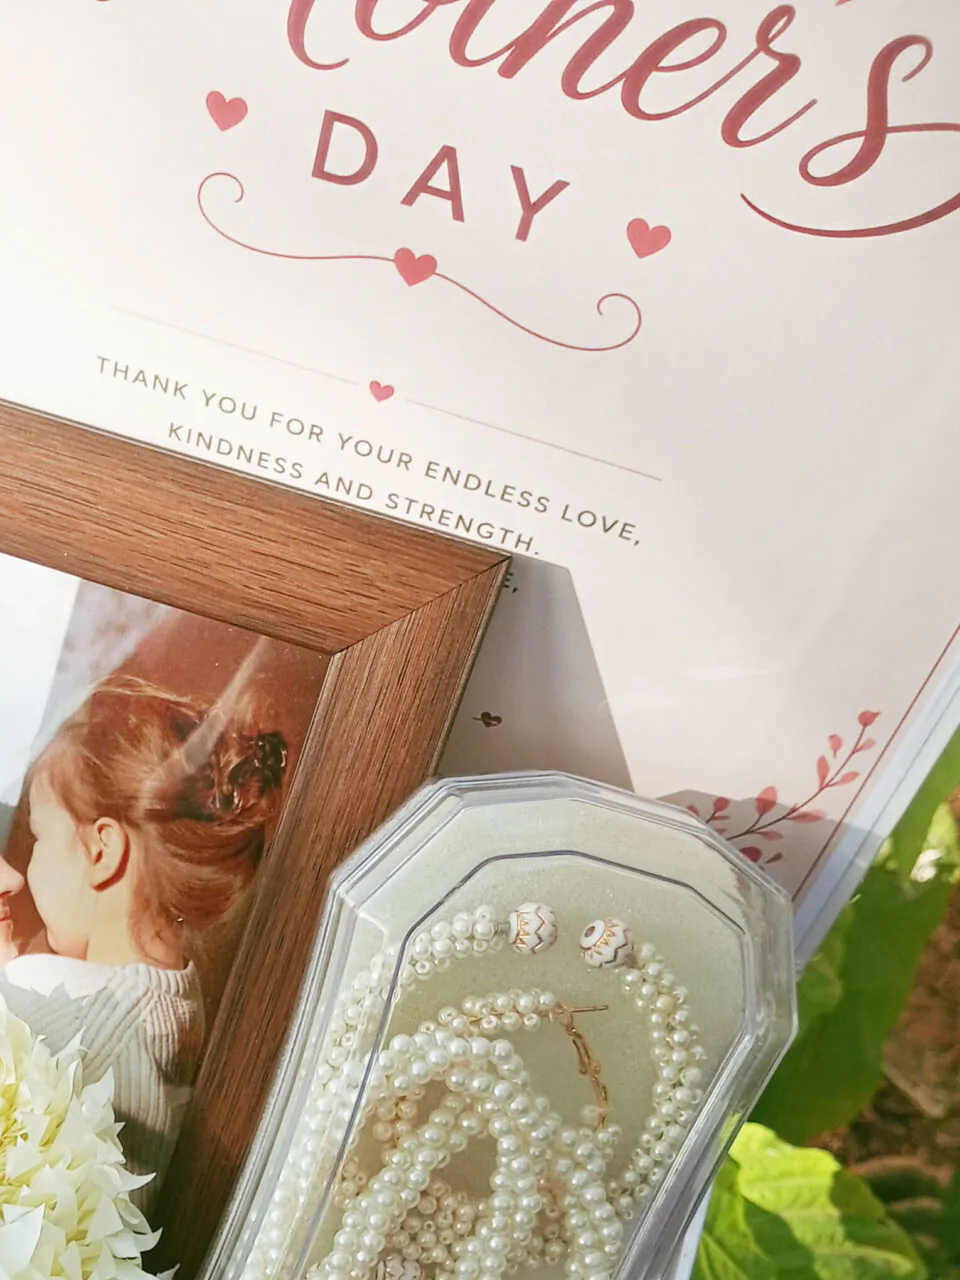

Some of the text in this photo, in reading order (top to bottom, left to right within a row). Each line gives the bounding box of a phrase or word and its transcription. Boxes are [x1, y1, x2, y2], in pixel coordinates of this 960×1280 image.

[311, 109, 570, 243] DAY
[97, 356, 642, 547] THANK YOU FOR YOUR ENDLESS LOVE,
[168, 422, 540, 556] KINDNESS AND STRENGTH.
